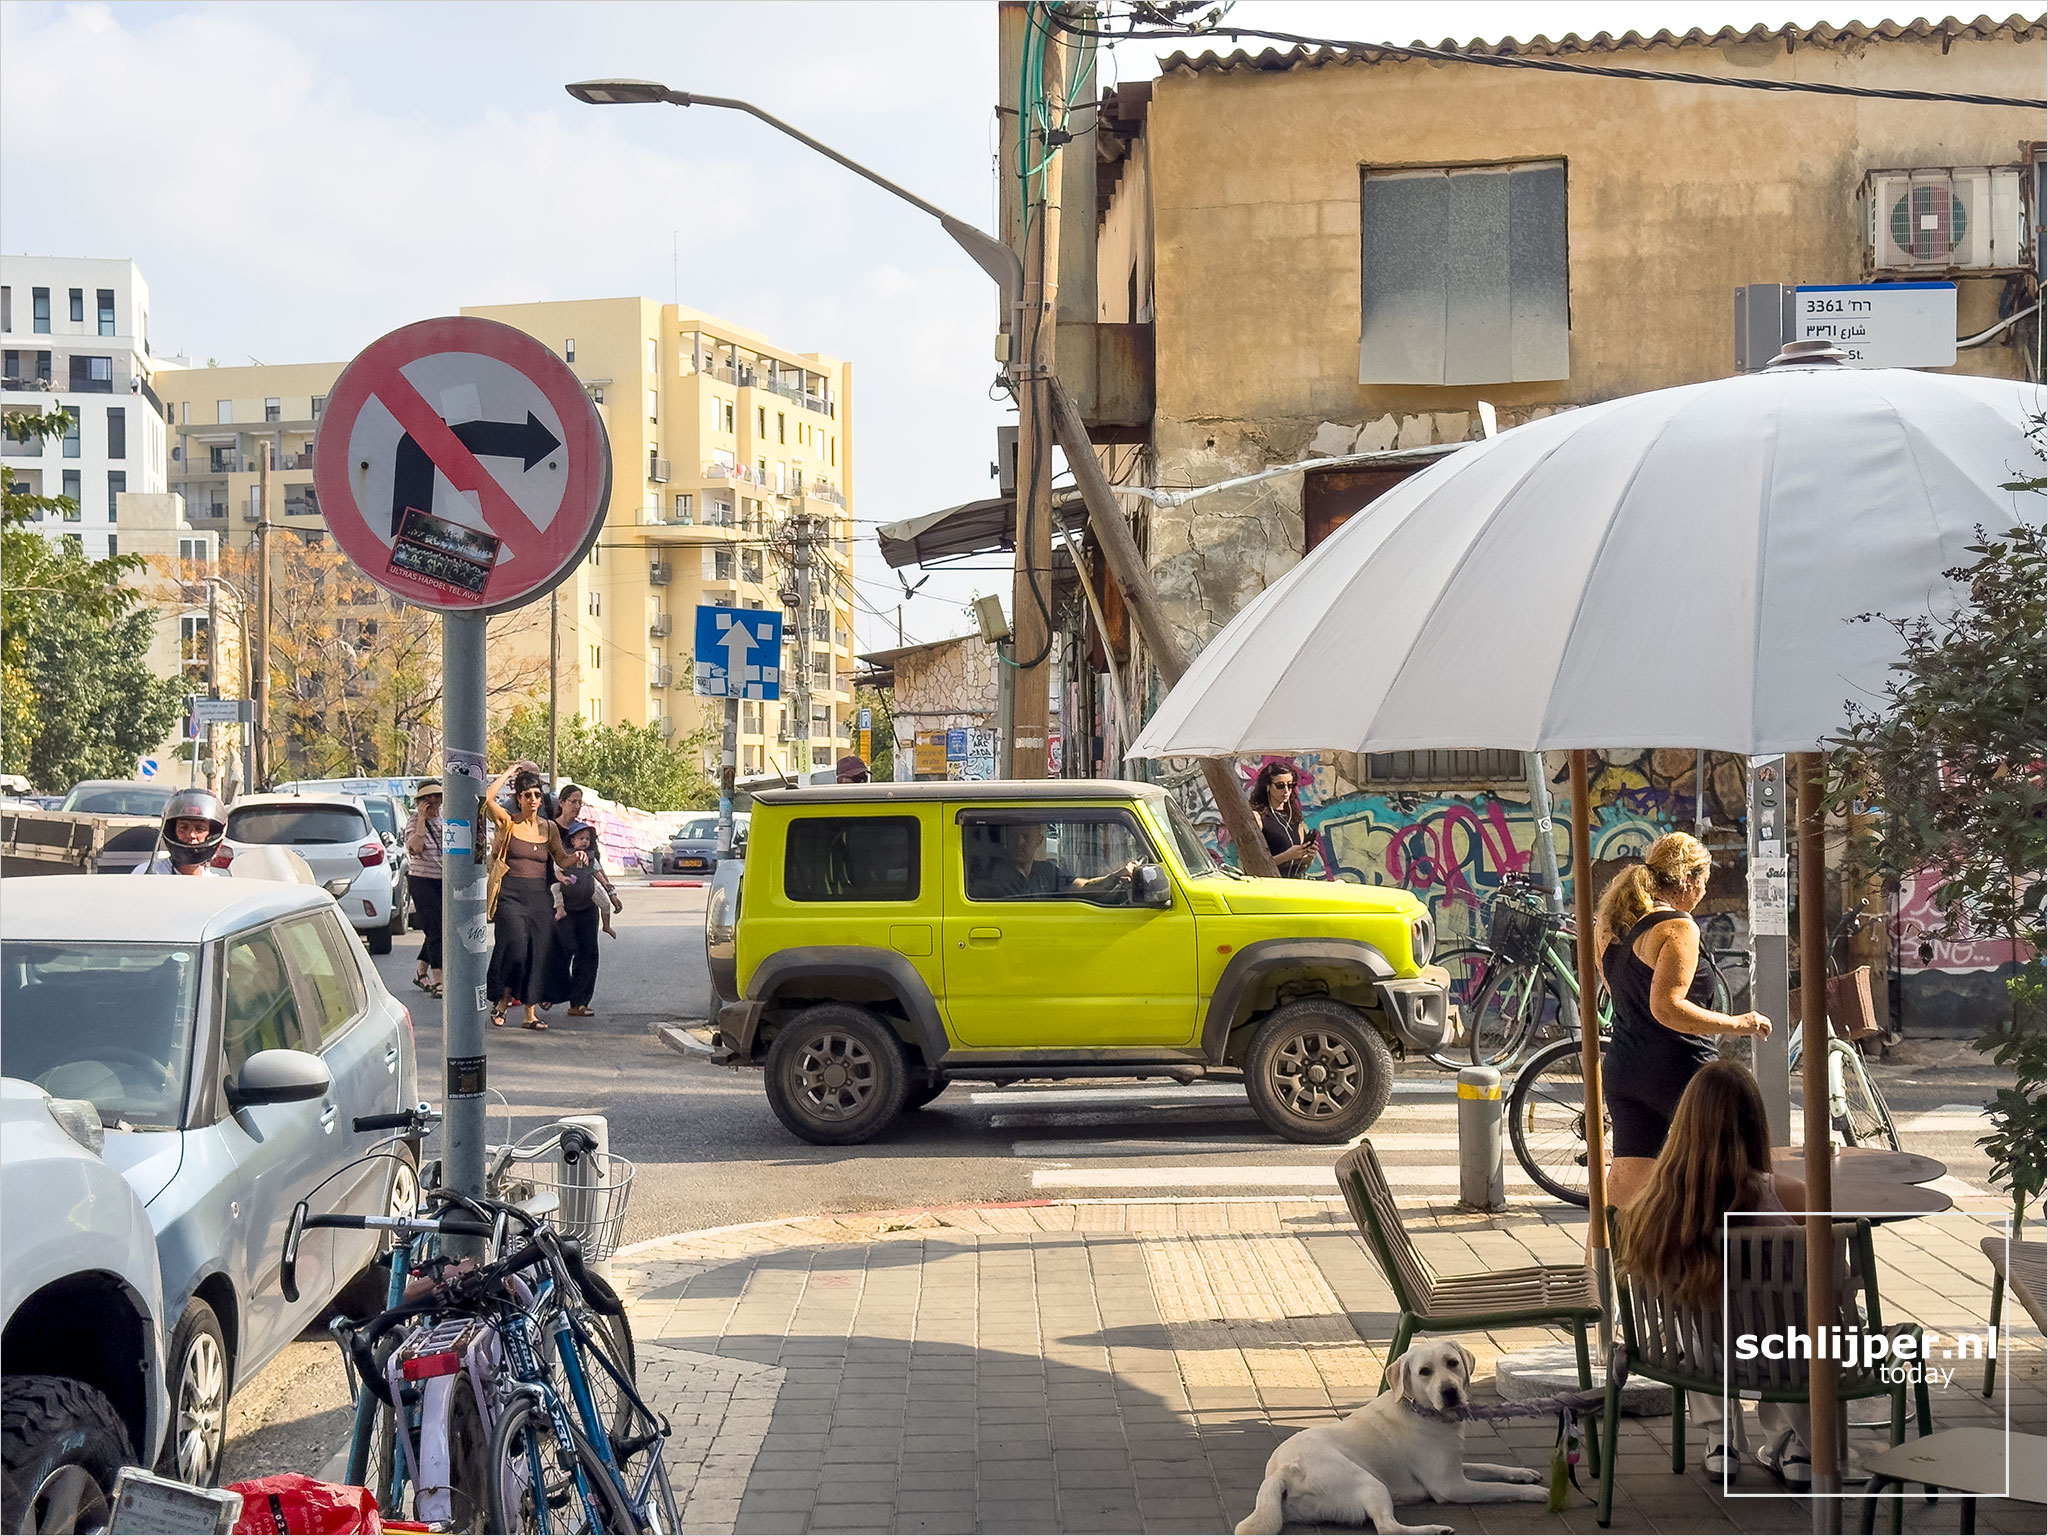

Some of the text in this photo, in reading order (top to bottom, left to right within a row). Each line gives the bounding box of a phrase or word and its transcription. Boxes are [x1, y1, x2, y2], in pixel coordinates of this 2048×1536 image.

[1806, 300, 1844, 313] 3361
[1840, 323, 1866, 340] شارع
[1848, 350, 1864, 360] St.
[390, 565, 480, 601] ULTRAS HAPOEL TEL AVIV
